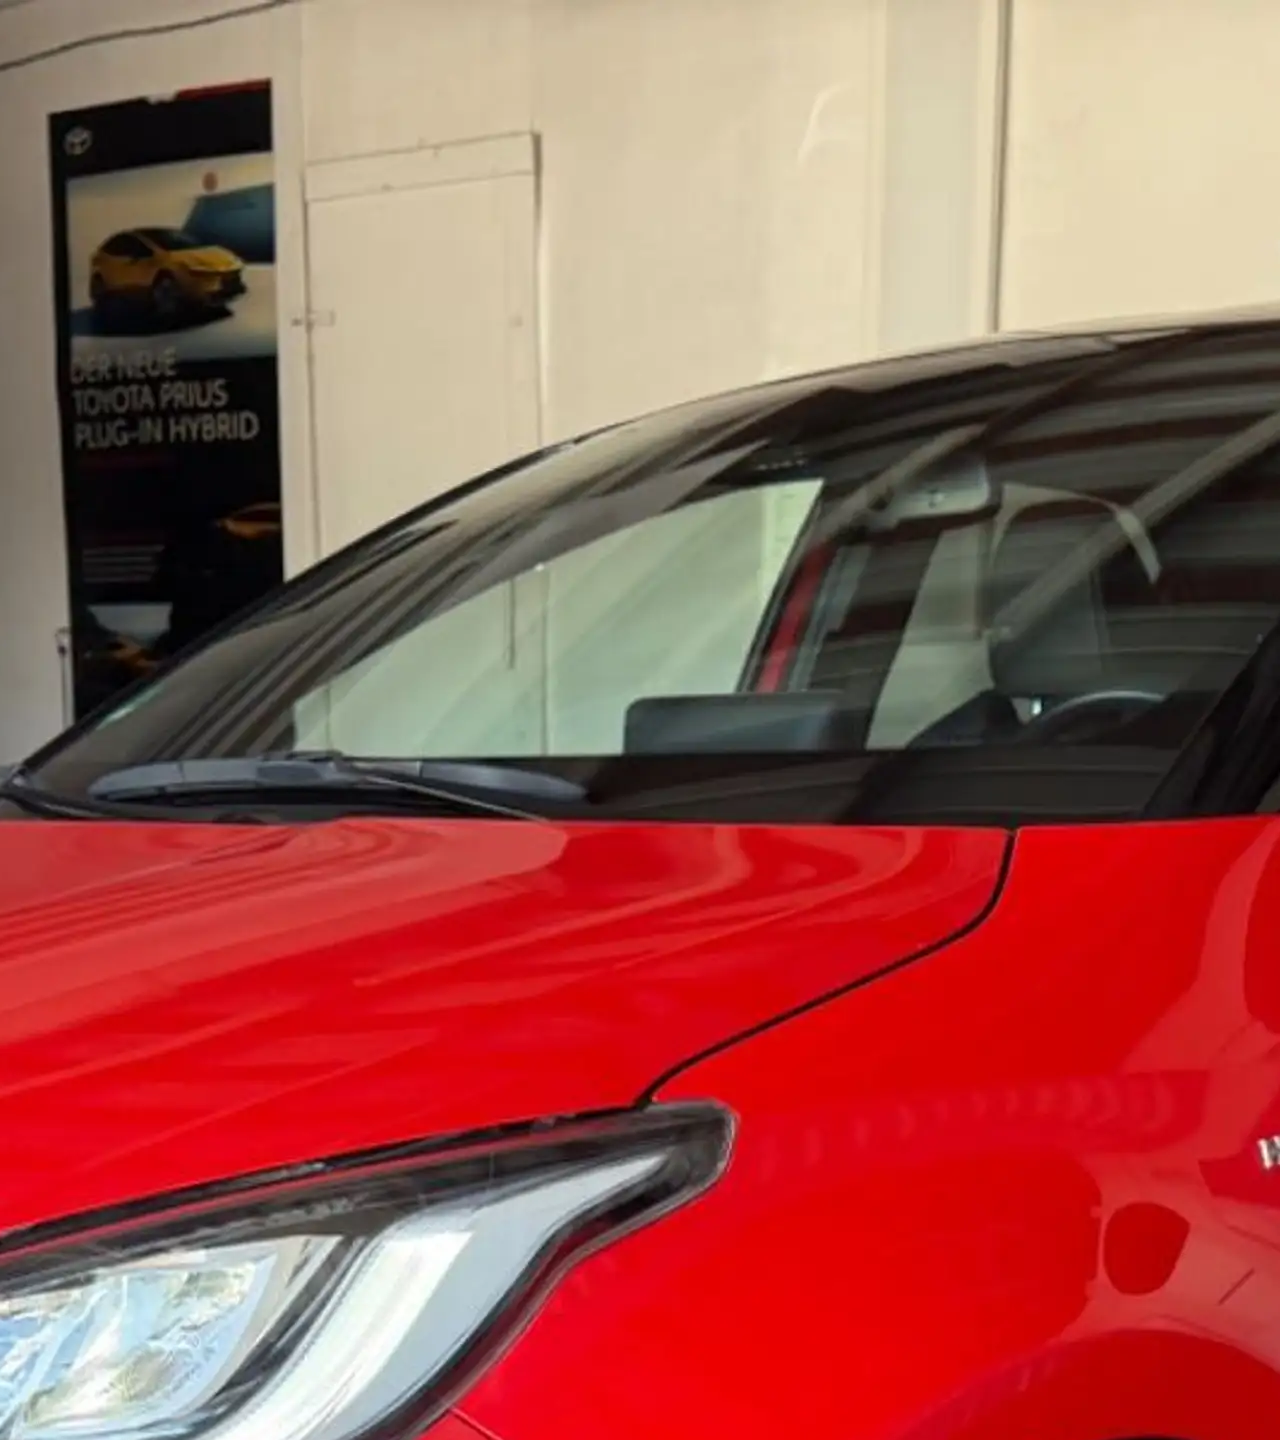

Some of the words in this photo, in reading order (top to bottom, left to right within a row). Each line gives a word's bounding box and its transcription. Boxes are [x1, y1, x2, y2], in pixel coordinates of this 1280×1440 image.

[72, 384, 156, 416] TOYOTA
[159, 378, 230, 411] PRIUS
[75, 417, 163, 450] PLUG-IN
[169, 410, 260, 444] HYBRID
